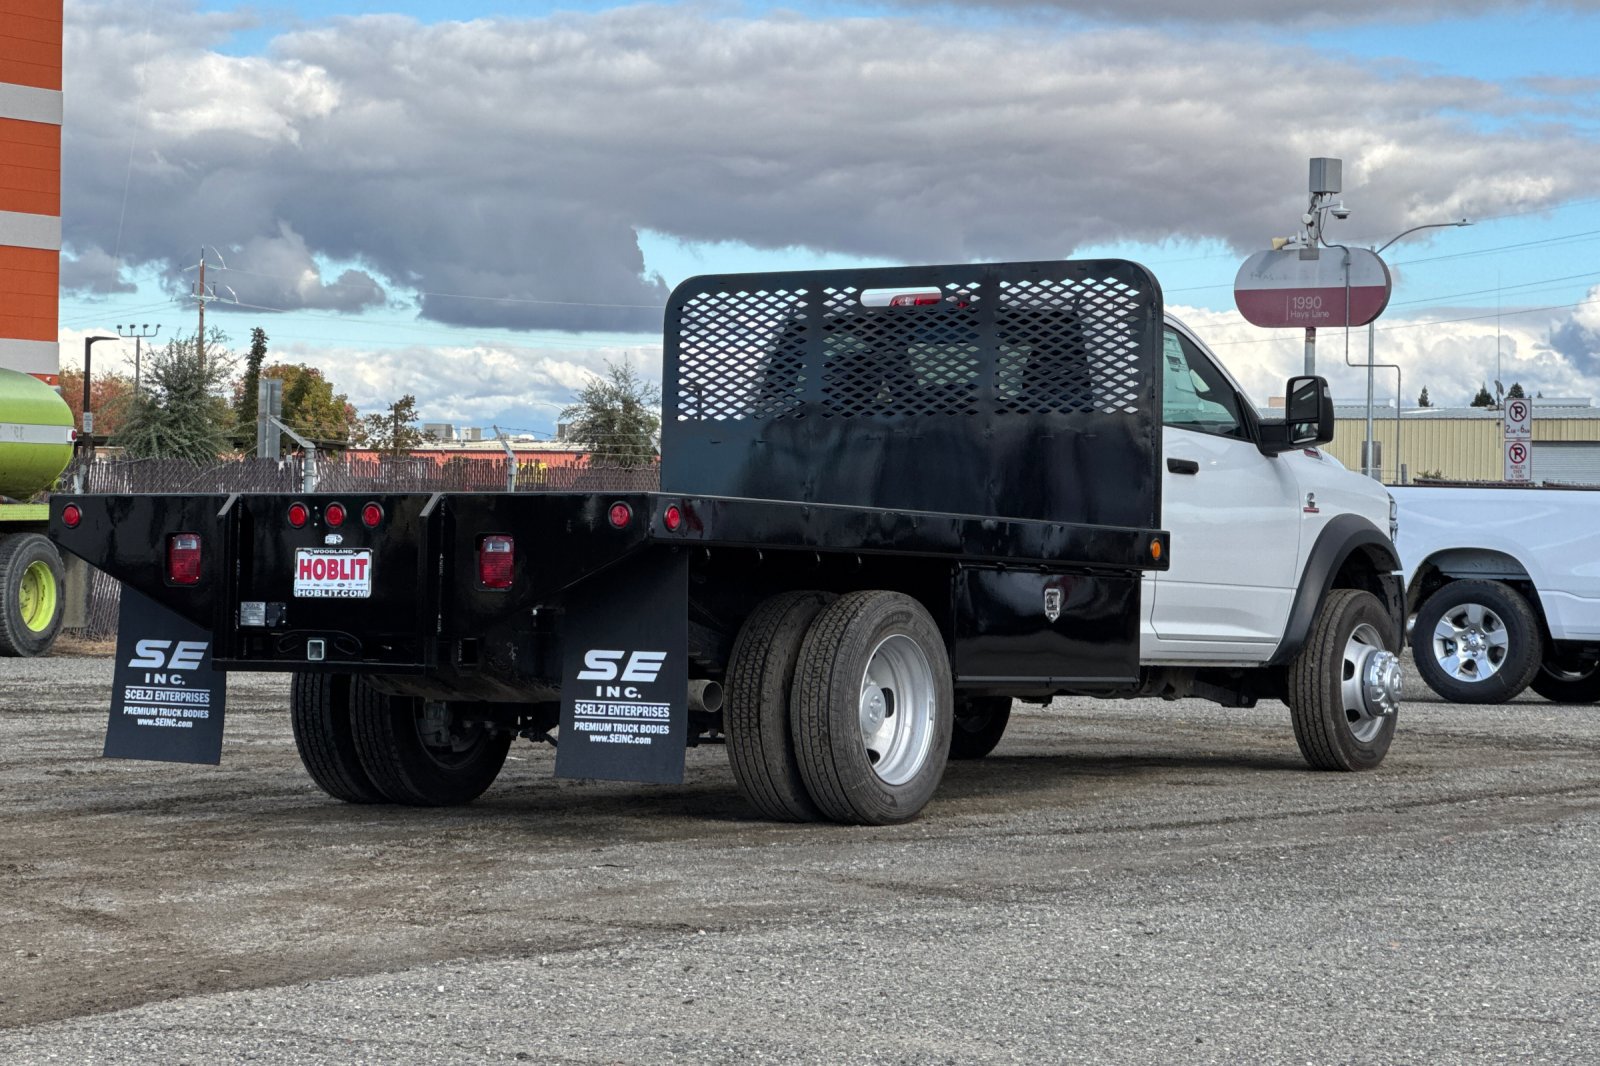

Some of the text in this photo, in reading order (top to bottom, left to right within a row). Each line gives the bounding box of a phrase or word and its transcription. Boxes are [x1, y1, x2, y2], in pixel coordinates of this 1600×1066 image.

[1292, 296, 1322, 309] 1990
[1291, 311, 1310, 319] Hays
[299, 558, 368, 581] HOBLIT
[297, 589, 367, 597] HOBLIT.COM
[127, 638, 209, 670] SE
[576, 649, 668, 682] SE
[144, 672, 186, 685] INC.
[124, 689, 210, 703] SCELZI ENTERPRISES
[596, 685, 642, 699] INC.
[123, 706, 209, 719] PREMIUM TRUCK BODIES
[574, 703, 670, 718] SCELZI ENTERPRISES
[137, 718, 193, 728] www.SEINC.com
[574, 721, 670, 735] PREMIUM TRUCK BODIES
[589, 734, 652, 745] www.SEINC.com
